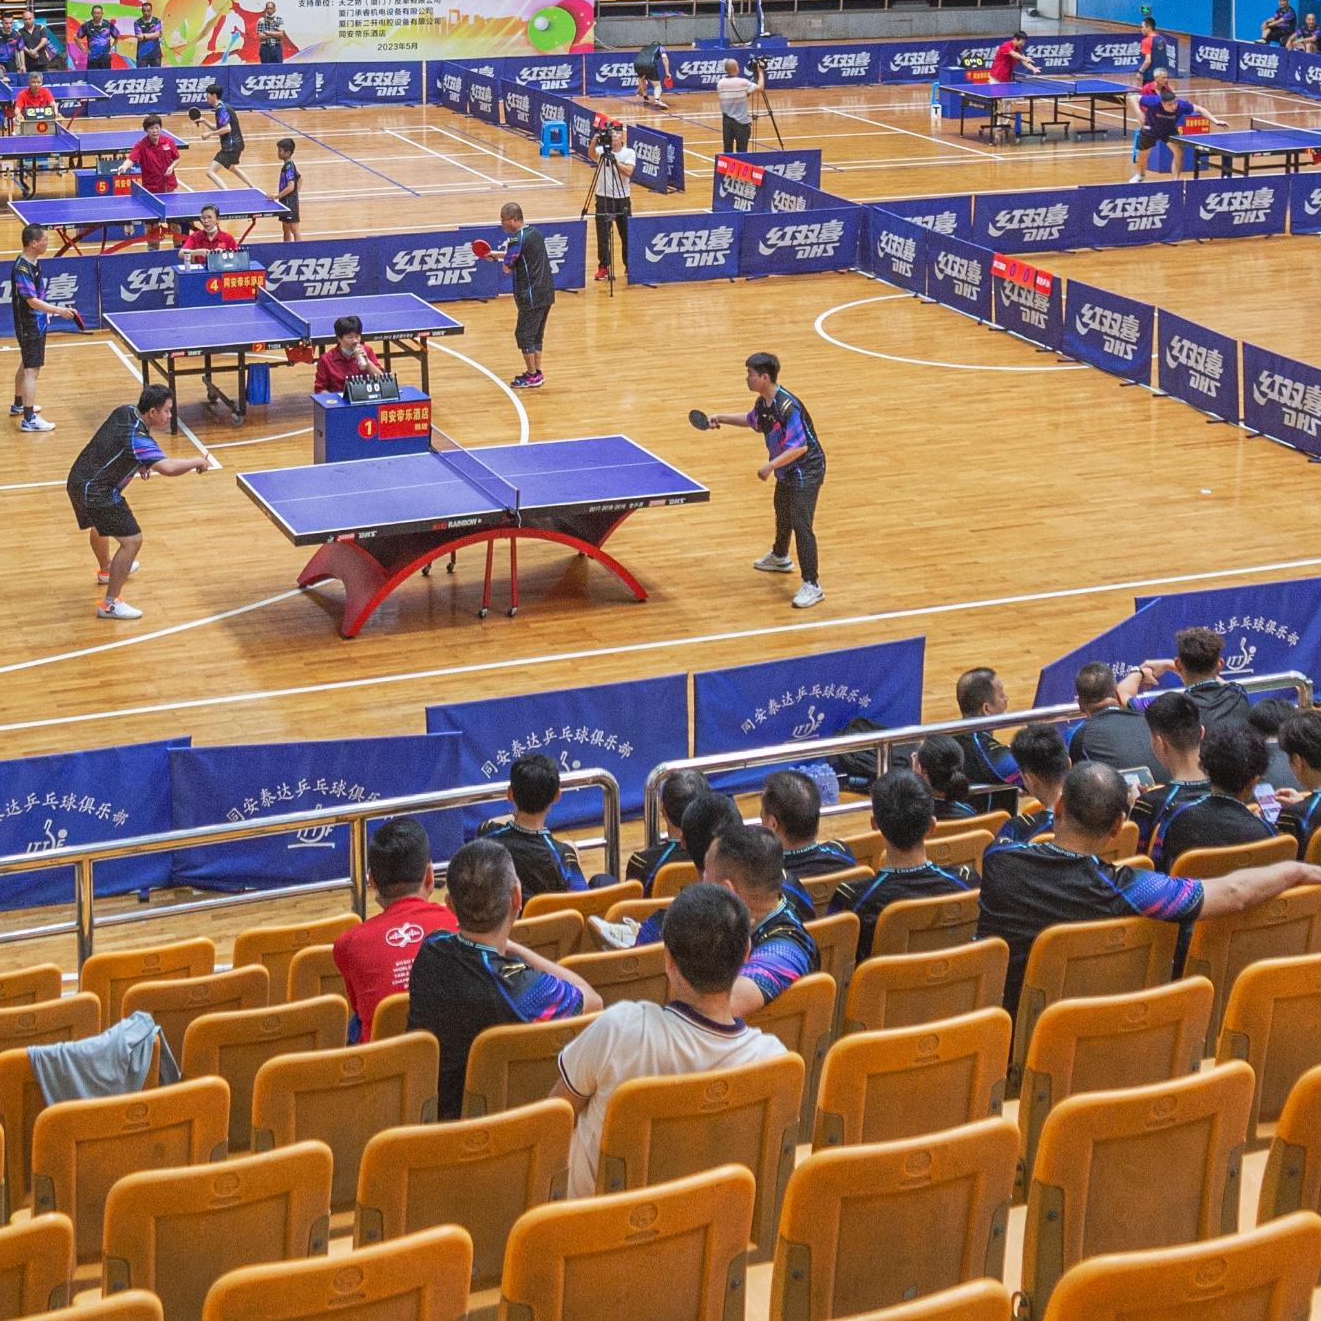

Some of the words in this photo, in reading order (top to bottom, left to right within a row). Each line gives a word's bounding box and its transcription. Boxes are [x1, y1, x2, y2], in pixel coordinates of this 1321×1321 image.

[377, 43, 418, 51] 2023年5月
[104, 77, 165, 105] 红双喜
[348, 69, 411, 96] 红双喜
[99, 182, 106, 192] 5
[1092, 192, 1171, 226] 红双喜
[1199, 186, 1275, 220] 红双喜
[988, 203, 1069, 237] 红双喜
[1127, 213, 1167, 232] DHS
[758, 219, 844, 255] 红双喜
[1023, 224, 1065, 242] DHS
[645, 225, 735, 263] 红双喜
[795, 241, 841, 260] DHS
[683, 247, 731, 267] DHS
[210, 278, 218, 291] 4
[427, 267, 477, 286] DHS
[304, 279, 356, 296] DHS
[1076, 303, 1141, 344] 红双喜
[1167, 335, 1224, 382] 红双喜
[379, 407, 429, 423] 同安帝乐酒店
[365, 420, 372, 435] 1
[448, 518, 477, 529] RAINBOW
[740, 683, 873, 734] 同安泰达乒乓球俱乐部
[481, 725, 635, 779] 同安泰达乒乓球俱乐部
